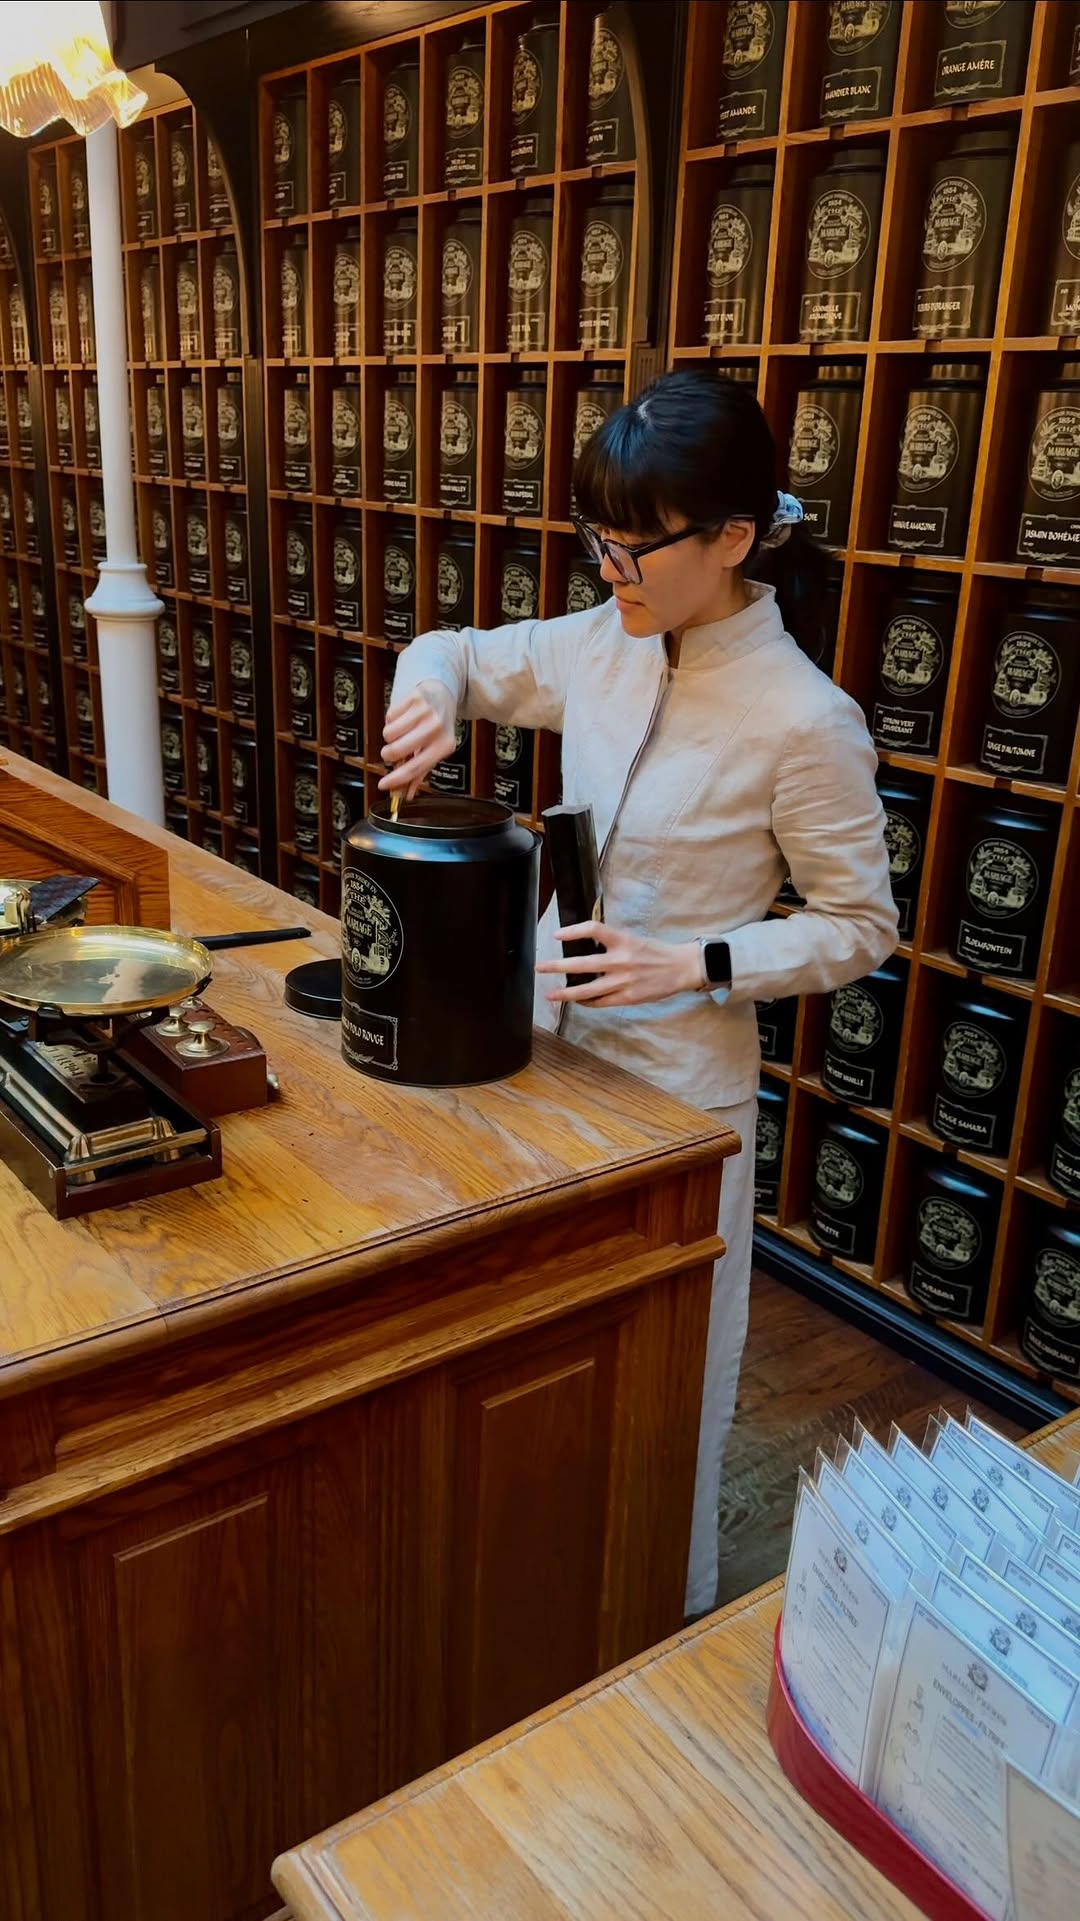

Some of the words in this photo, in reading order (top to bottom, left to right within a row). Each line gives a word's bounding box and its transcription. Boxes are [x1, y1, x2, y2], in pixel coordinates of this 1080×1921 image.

[942, 62, 966, 76] ORANGE
[850, 85, 872, 95] BLANC
[730, 105, 757, 117] AMANDE
[1024, 529, 1048, 540] JASMIN
[350, 879, 364, 893] 1854
[346, 913, 373, 938] MARIAGE
[362, 1028, 385, 1047] ROUGE
[938, 1109, 957, 1126] ROUGE
[957, 1119, 988, 1134] SAHARA
[932, 1677, 975, 1723] ENVELOPPES
